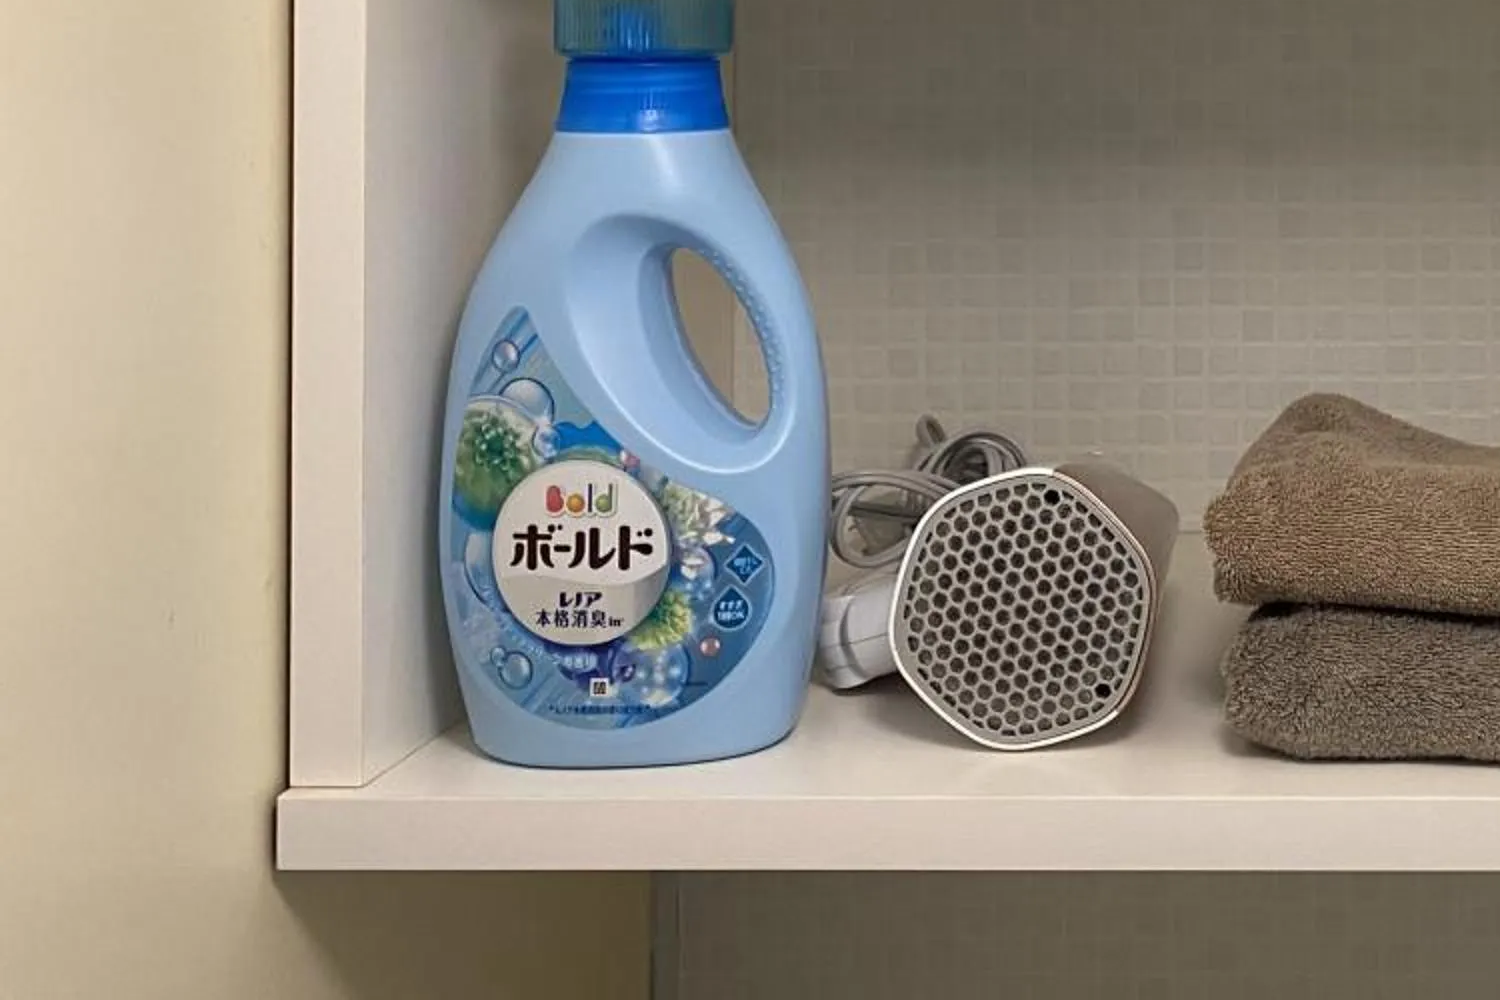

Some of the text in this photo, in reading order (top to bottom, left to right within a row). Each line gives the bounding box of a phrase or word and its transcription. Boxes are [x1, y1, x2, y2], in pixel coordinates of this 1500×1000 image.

[510, 525, 653, 570] ボールド
[559, 591, 602, 607] レノア
